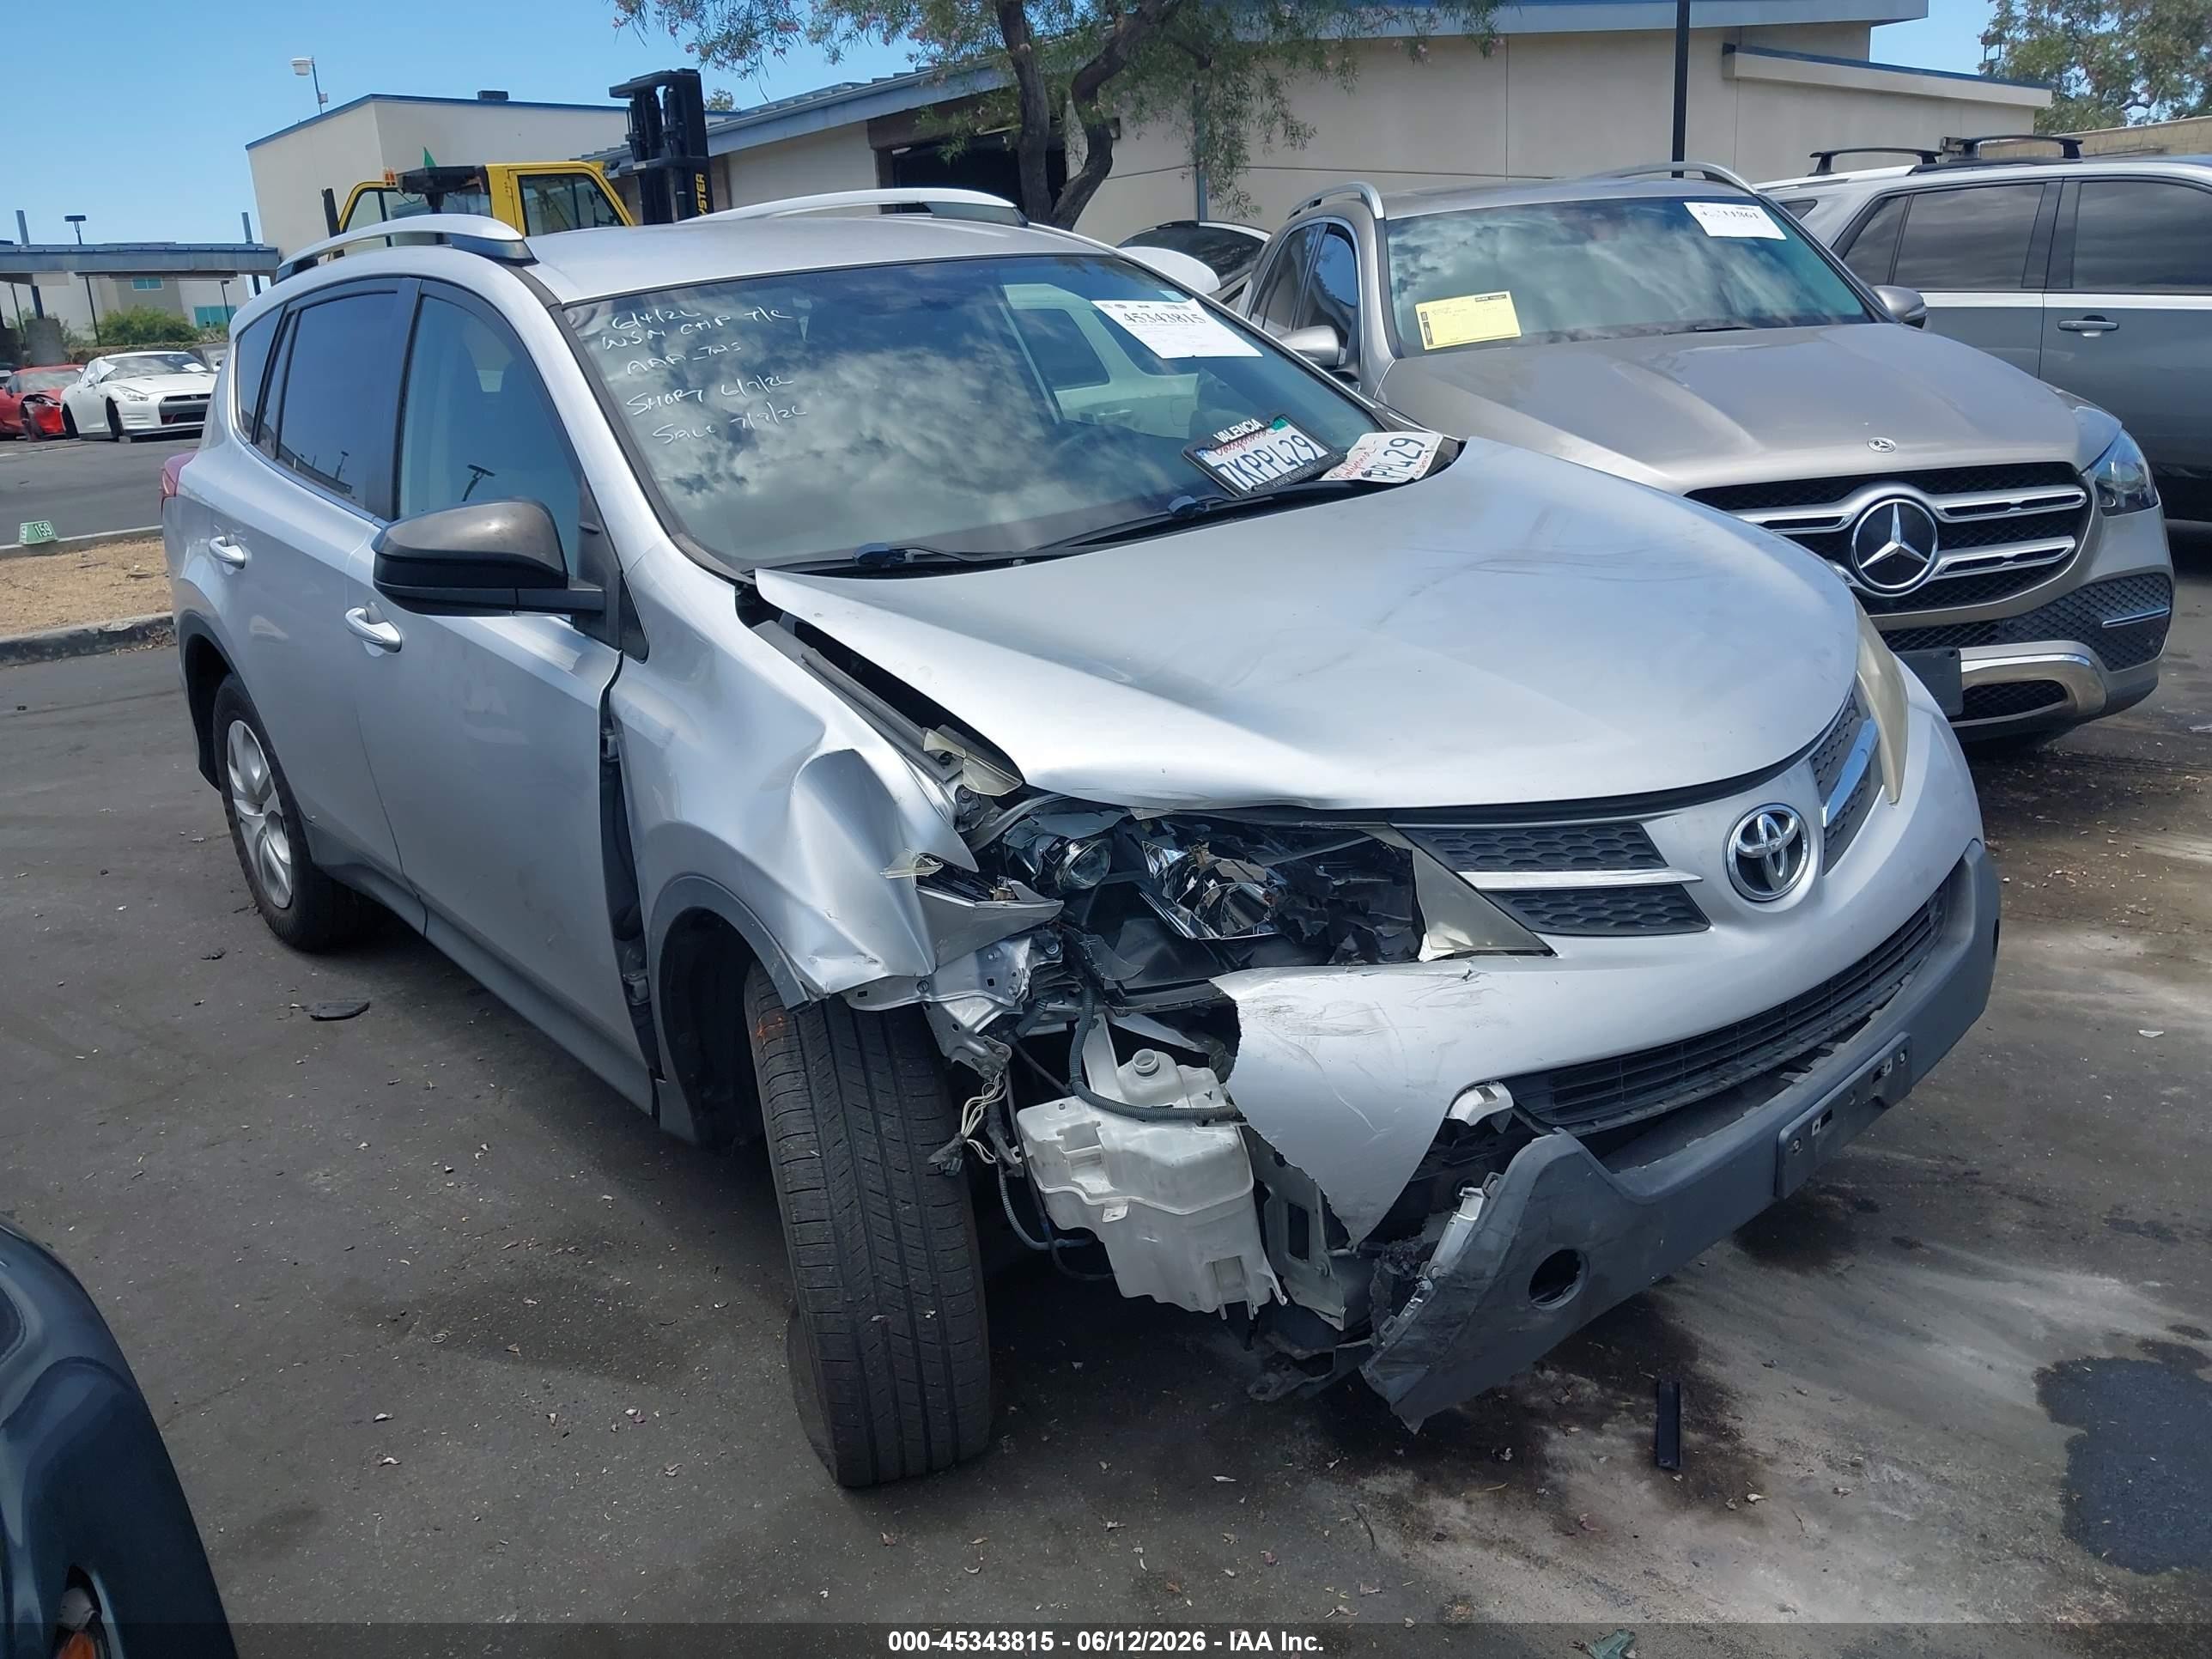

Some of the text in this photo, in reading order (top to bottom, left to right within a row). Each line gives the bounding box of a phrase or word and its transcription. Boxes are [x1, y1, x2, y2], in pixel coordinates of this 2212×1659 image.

[696, 173, 708, 216] YSTER
[1123, 313, 1206, 324] 45343815
[1212, 418, 1265, 443] VALENCIA
[1213, 434, 1320, 492] 7KPP429
[1369, 437, 1425, 479] PP429
[34, 522, 52, 538] 159
